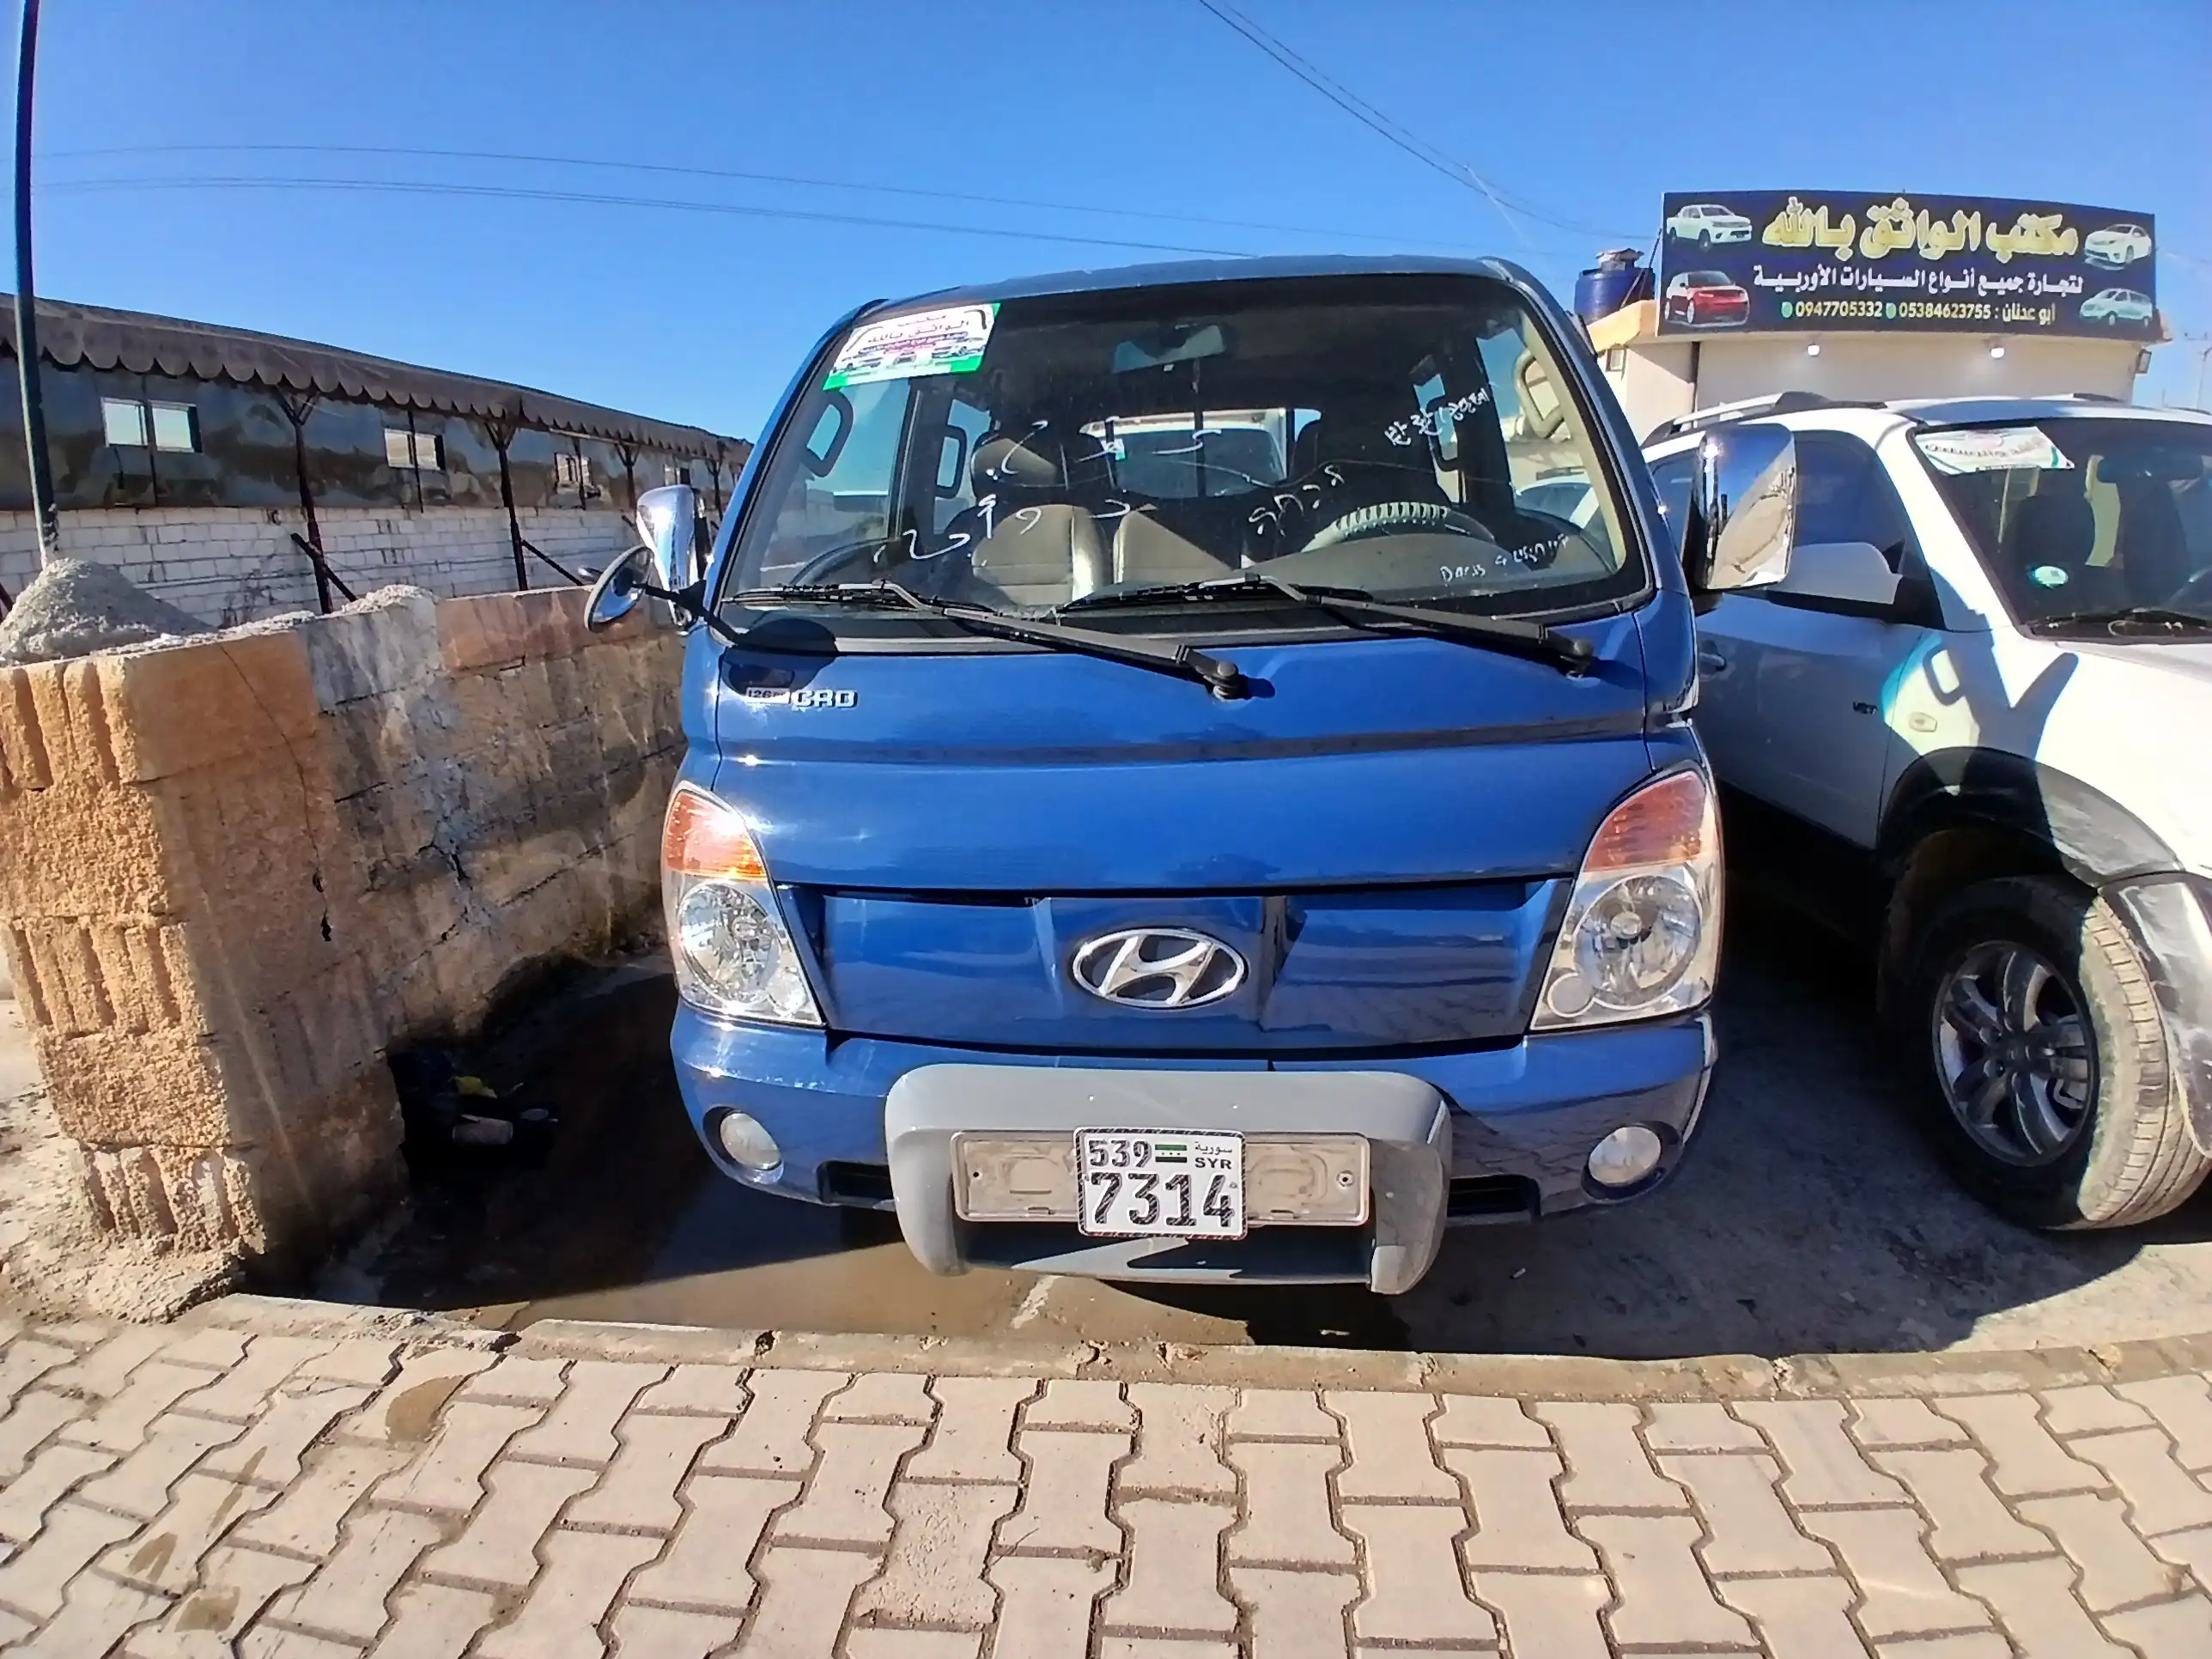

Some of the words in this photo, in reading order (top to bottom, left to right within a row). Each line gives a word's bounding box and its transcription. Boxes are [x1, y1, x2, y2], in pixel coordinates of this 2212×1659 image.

[1762, 196, 1856, 261] بالله
[1859, 197, 1981, 260] الواثق
[1985, 213, 2079, 264] مكتب
[1753, 263, 1837, 293] الأوربية
[1840, 266, 1926, 293] السيارات
[1929, 266, 1975, 294] أنواع
[1978, 274, 2024, 296] جميع
[2027, 271, 2083, 297] لتجارة
[1795, 301, 1883, 318] 0947705332
[1899, 301, 1991, 319] 05384623755
[2002, 303, 2036, 323] عدنان
[1088, 1139, 1152, 1169] 539
[1194, 1140, 1233, 1156] سورية
[1194, 1157, 1232, 1170] SYR
[1090, 1171, 1235, 1228] 7314
